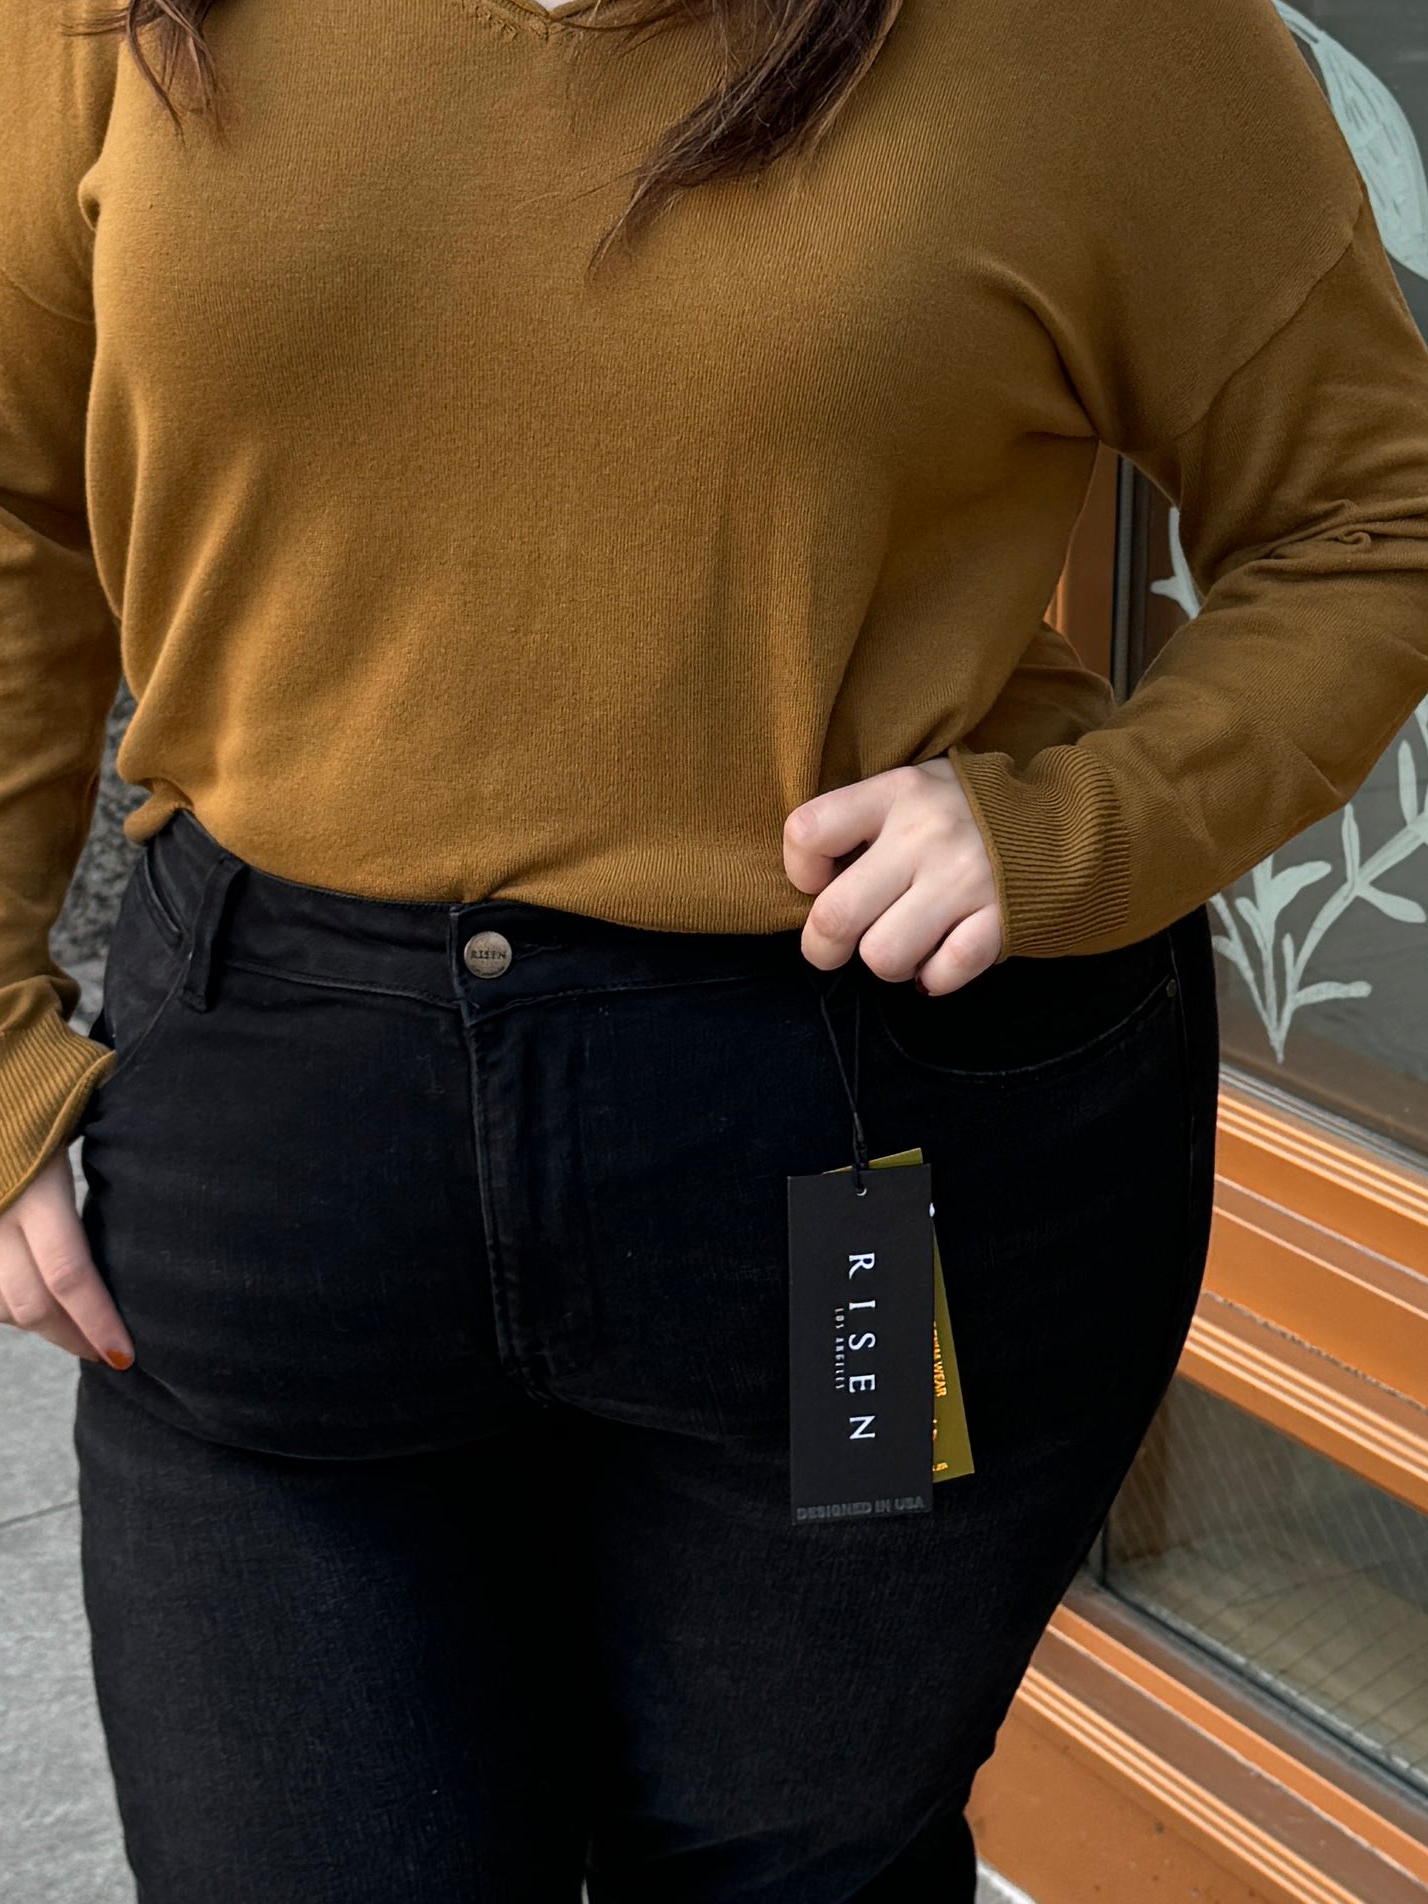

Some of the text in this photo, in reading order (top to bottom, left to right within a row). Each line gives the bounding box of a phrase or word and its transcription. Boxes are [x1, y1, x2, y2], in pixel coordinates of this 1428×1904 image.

[834, 1307, 845, 1330] LOS
[848, 1252, 876, 1440] RISEN
[796, 1495, 925, 1521] DESIGNED IN USA
